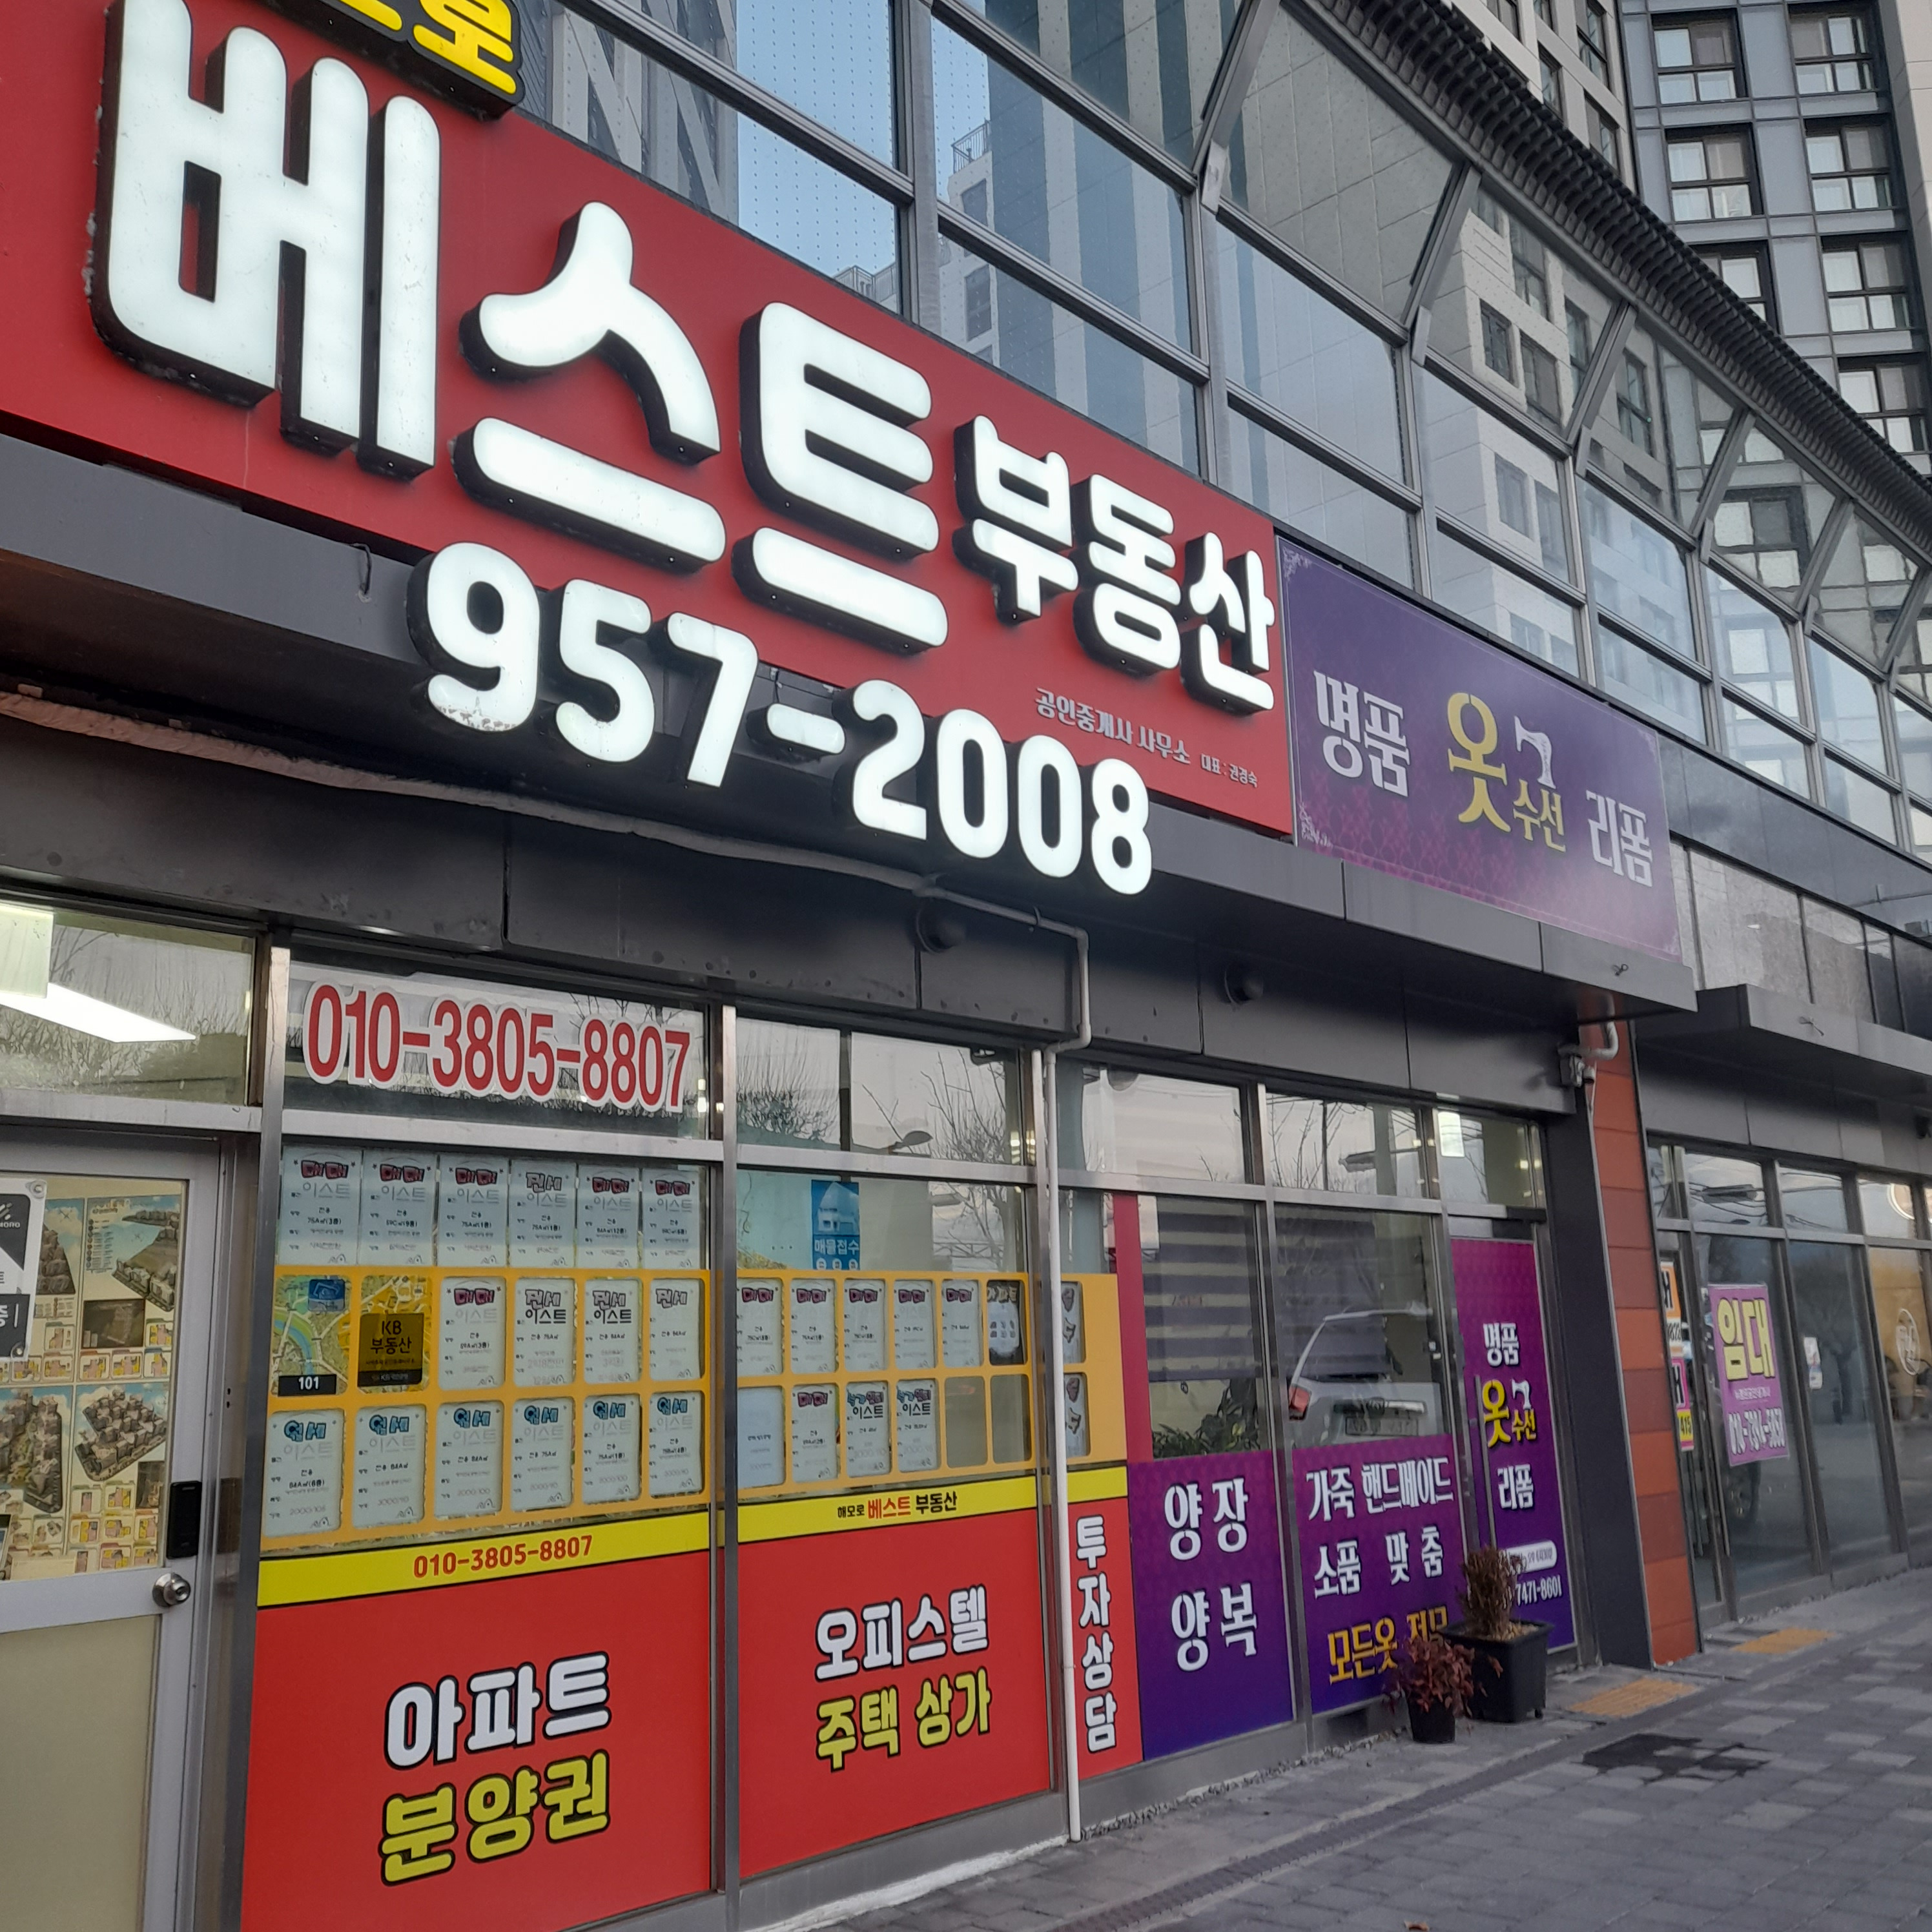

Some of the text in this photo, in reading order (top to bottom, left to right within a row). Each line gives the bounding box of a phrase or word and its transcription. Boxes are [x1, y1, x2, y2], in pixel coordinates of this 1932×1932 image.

[427, 542, 1152, 895] 957-2008
[1035, 688, 1133, 745] 공인중개사
[1137, 726, 1191, 765] 사무소
[1313, 670, 1410, 797] 명품
[1586, 789, 1653, 887] 리폼
[308, 984, 690, 1107] 010-3805-8807
[382, 1321, 402, 1335] KB
[526, 1310, 566, 1324] 이스트
[594, 1310, 632, 1324] 이스트
[1716, 1297, 1775, 1381] 임대
[371, 1337, 412, 1354] 부동산
[1483, 1322, 1519, 1366] 명품
[298, 1376, 319, 1390] 101
[852, 1404, 883, 1420] 이스트
[902, 1403, 930, 1416] 이스트
[838, 1491, 957, 1519] 해모로 베스트 부동산
[1306, 1457, 1454, 1522] 가죽 핸드메이드
[1497, 1464, 1534, 1510] 리폼
[413, 1535, 593, 1579] 010-3805-8807
[1315, 1540, 1361, 1599] 소품
[816, 1585, 989, 1681] 오피스텔
[387, 1653, 610, 1767] 아파트
[817, 1668, 991, 1771] 주택 상가
[382, 1752, 608, 1883] 분양권
